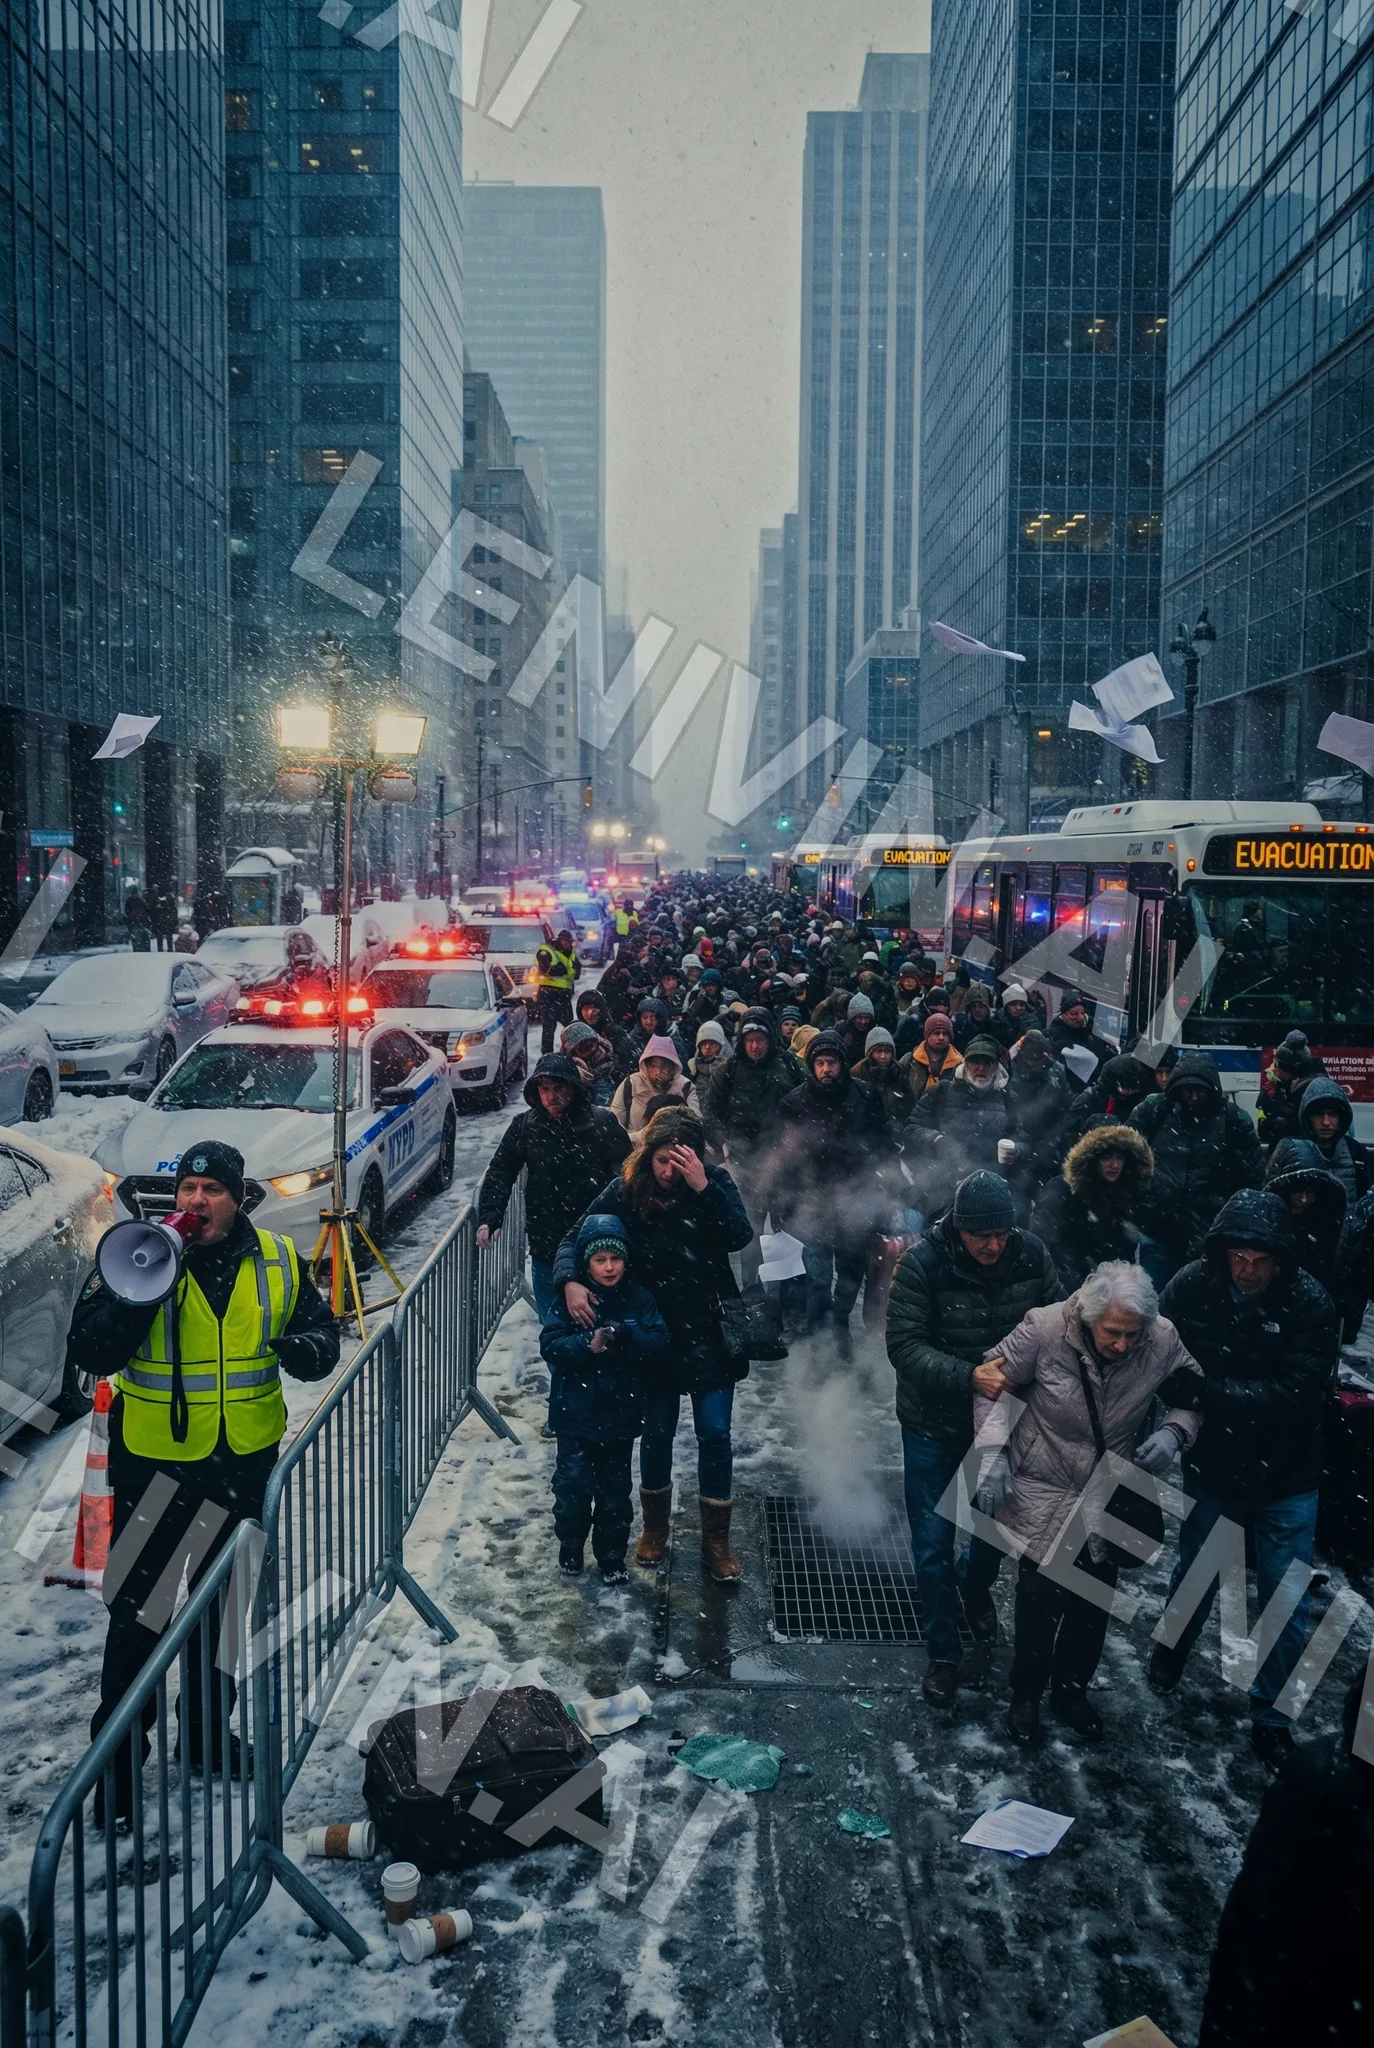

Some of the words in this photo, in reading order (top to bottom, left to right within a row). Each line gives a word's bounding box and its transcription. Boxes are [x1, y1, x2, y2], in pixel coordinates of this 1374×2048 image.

[884, 850, 951, 864] EVACUATION
[1236, 841, 1374, 869] EVACUATION
[388, 1119, 414, 1173] NYPD
